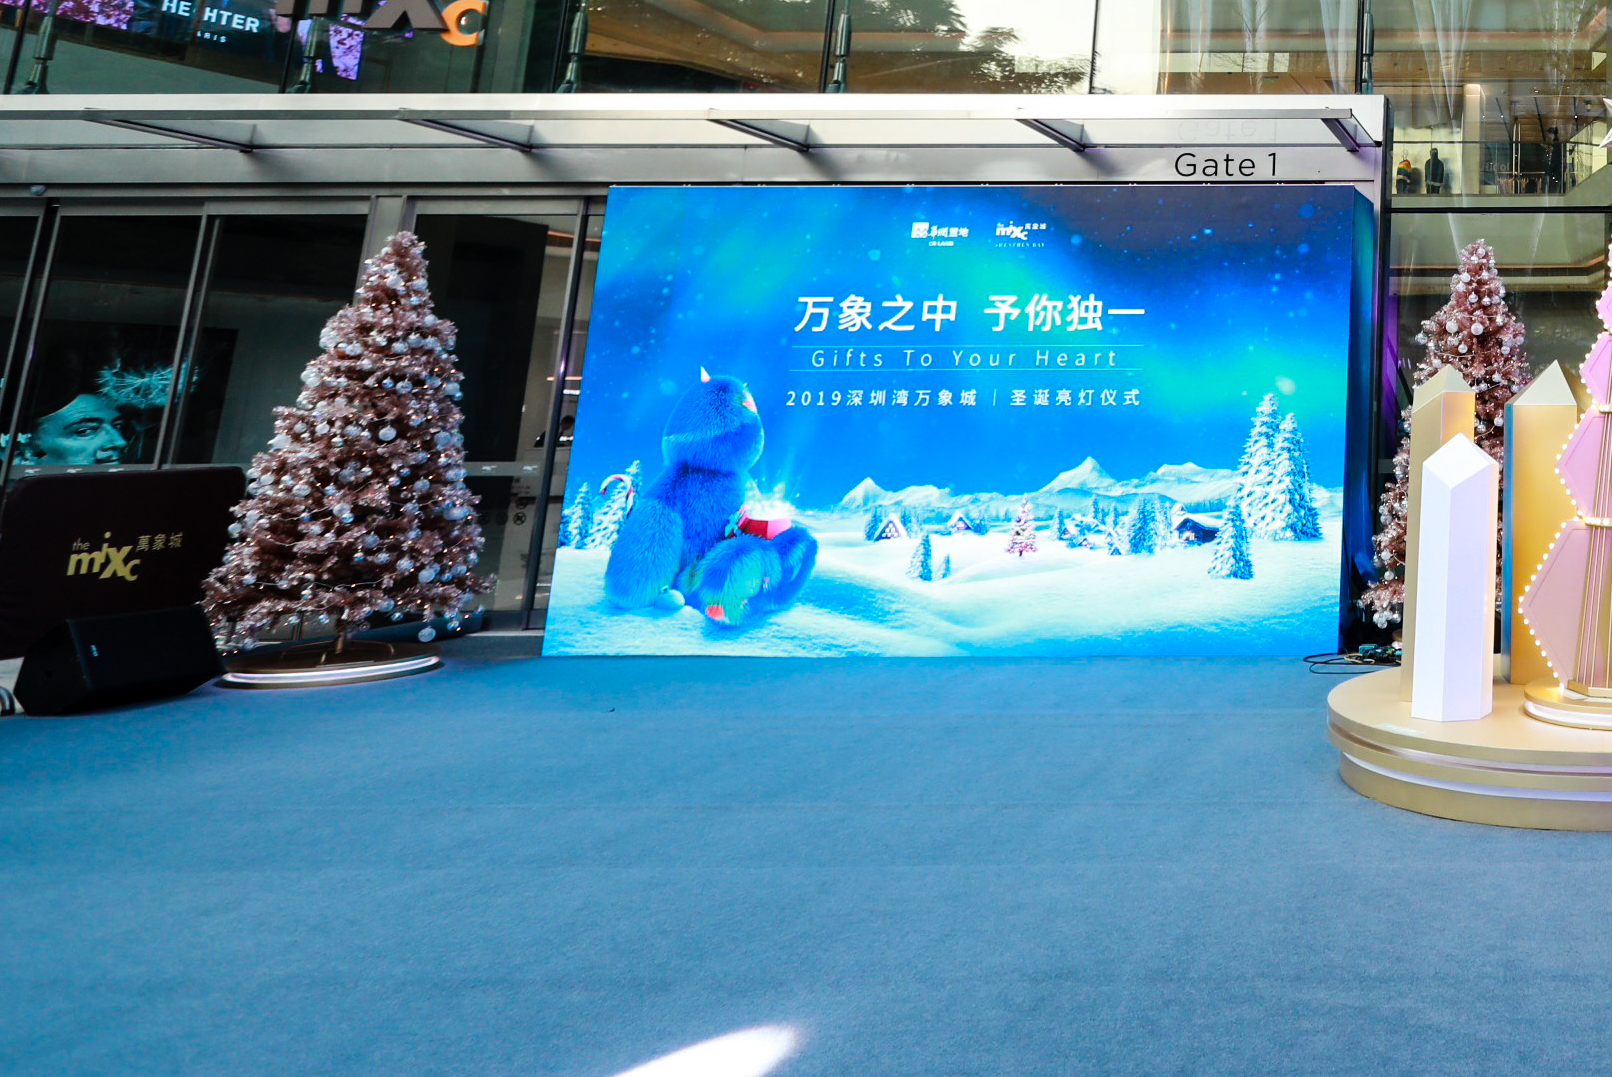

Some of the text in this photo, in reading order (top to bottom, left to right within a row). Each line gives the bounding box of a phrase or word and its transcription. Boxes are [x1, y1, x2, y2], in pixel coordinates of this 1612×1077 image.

[1174, 152, 1277, 177] Gate 1
[794, 293, 1146, 332] 万象之中 予你独一
[810, 349, 1117, 368] Gifts To Your Heart
[1010, 389, 1142, 407] 圣诞亮灯仪式
[71, 537, 91, 551] the
[136, 532, 184, 552] 萬象城
